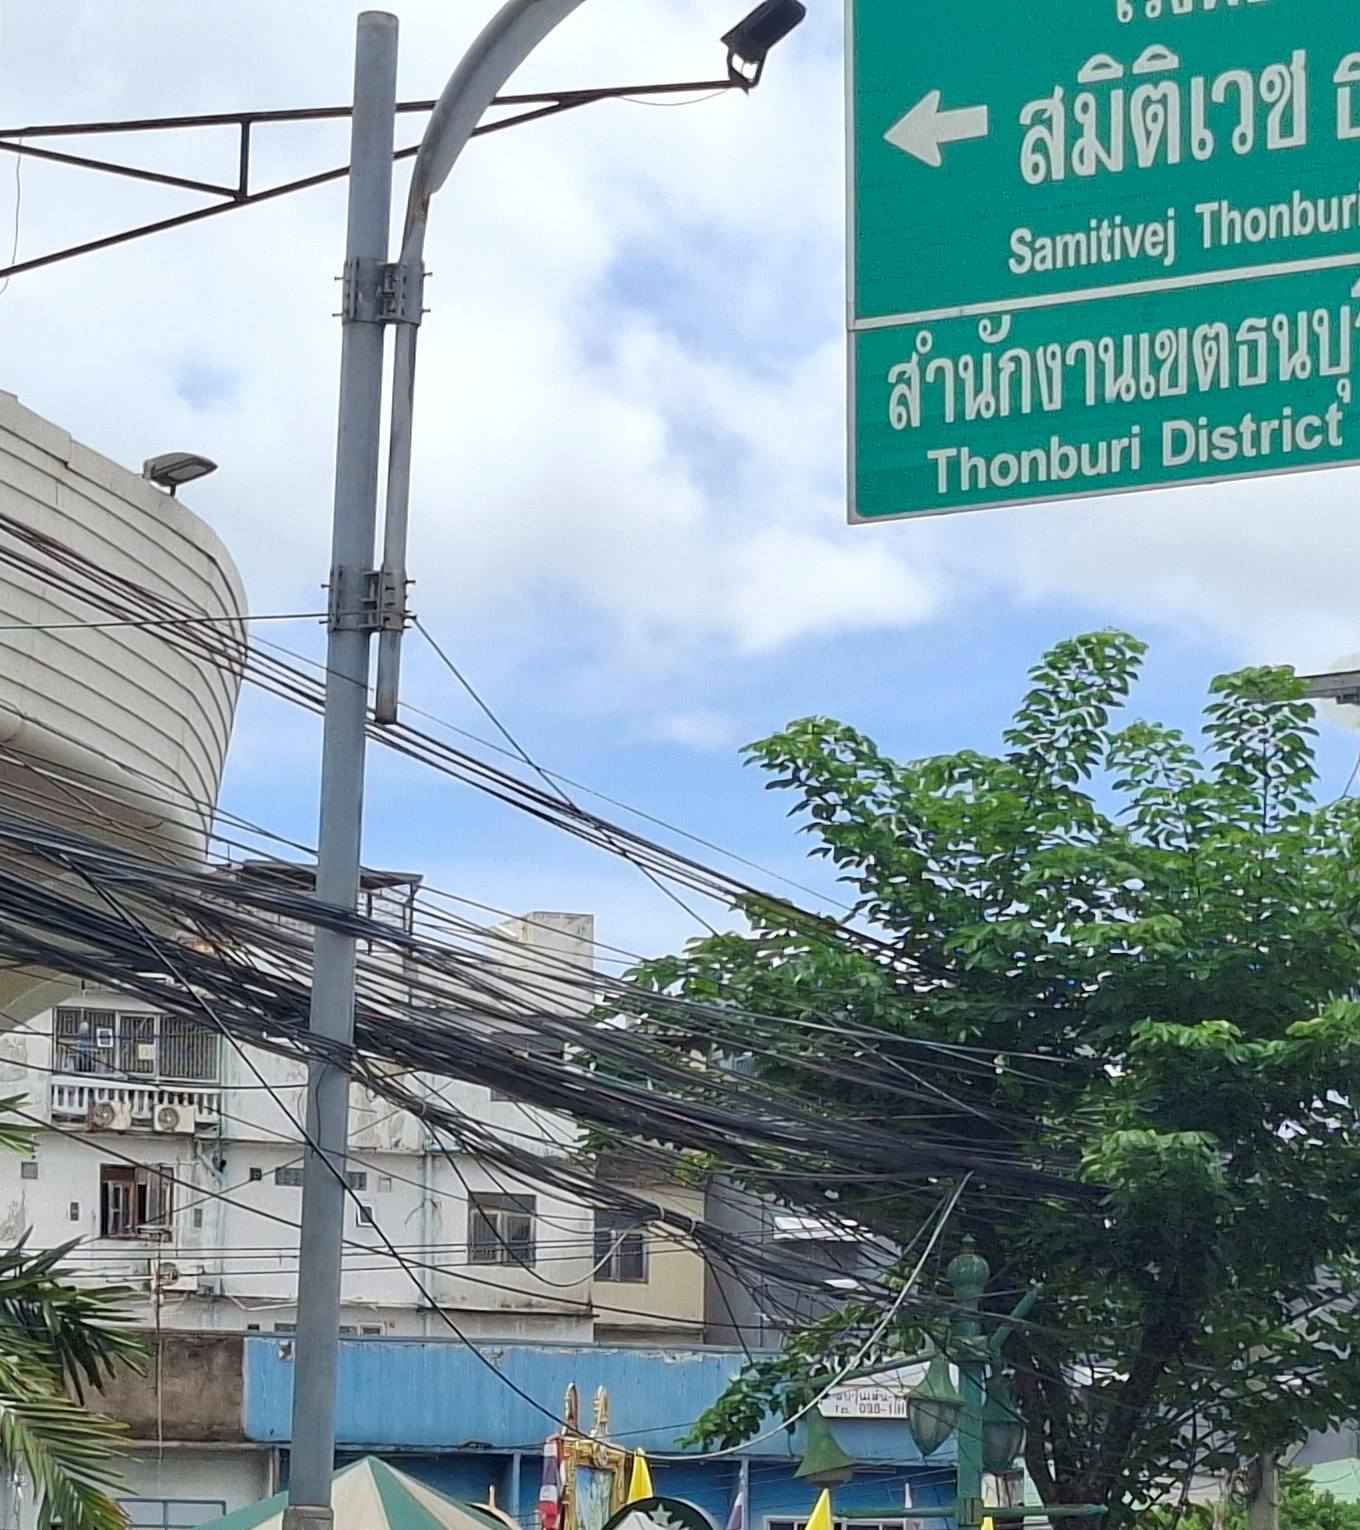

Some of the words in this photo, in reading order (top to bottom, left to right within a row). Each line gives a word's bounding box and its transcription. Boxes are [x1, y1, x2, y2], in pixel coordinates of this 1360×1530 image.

[1019, 44, 1307, 185] สมิติเวช
[1008, 209, 1176, 274] Samitivej
[927, 427, 1140, 493] Thonburi
[1162, 402, 1343, 466] District
